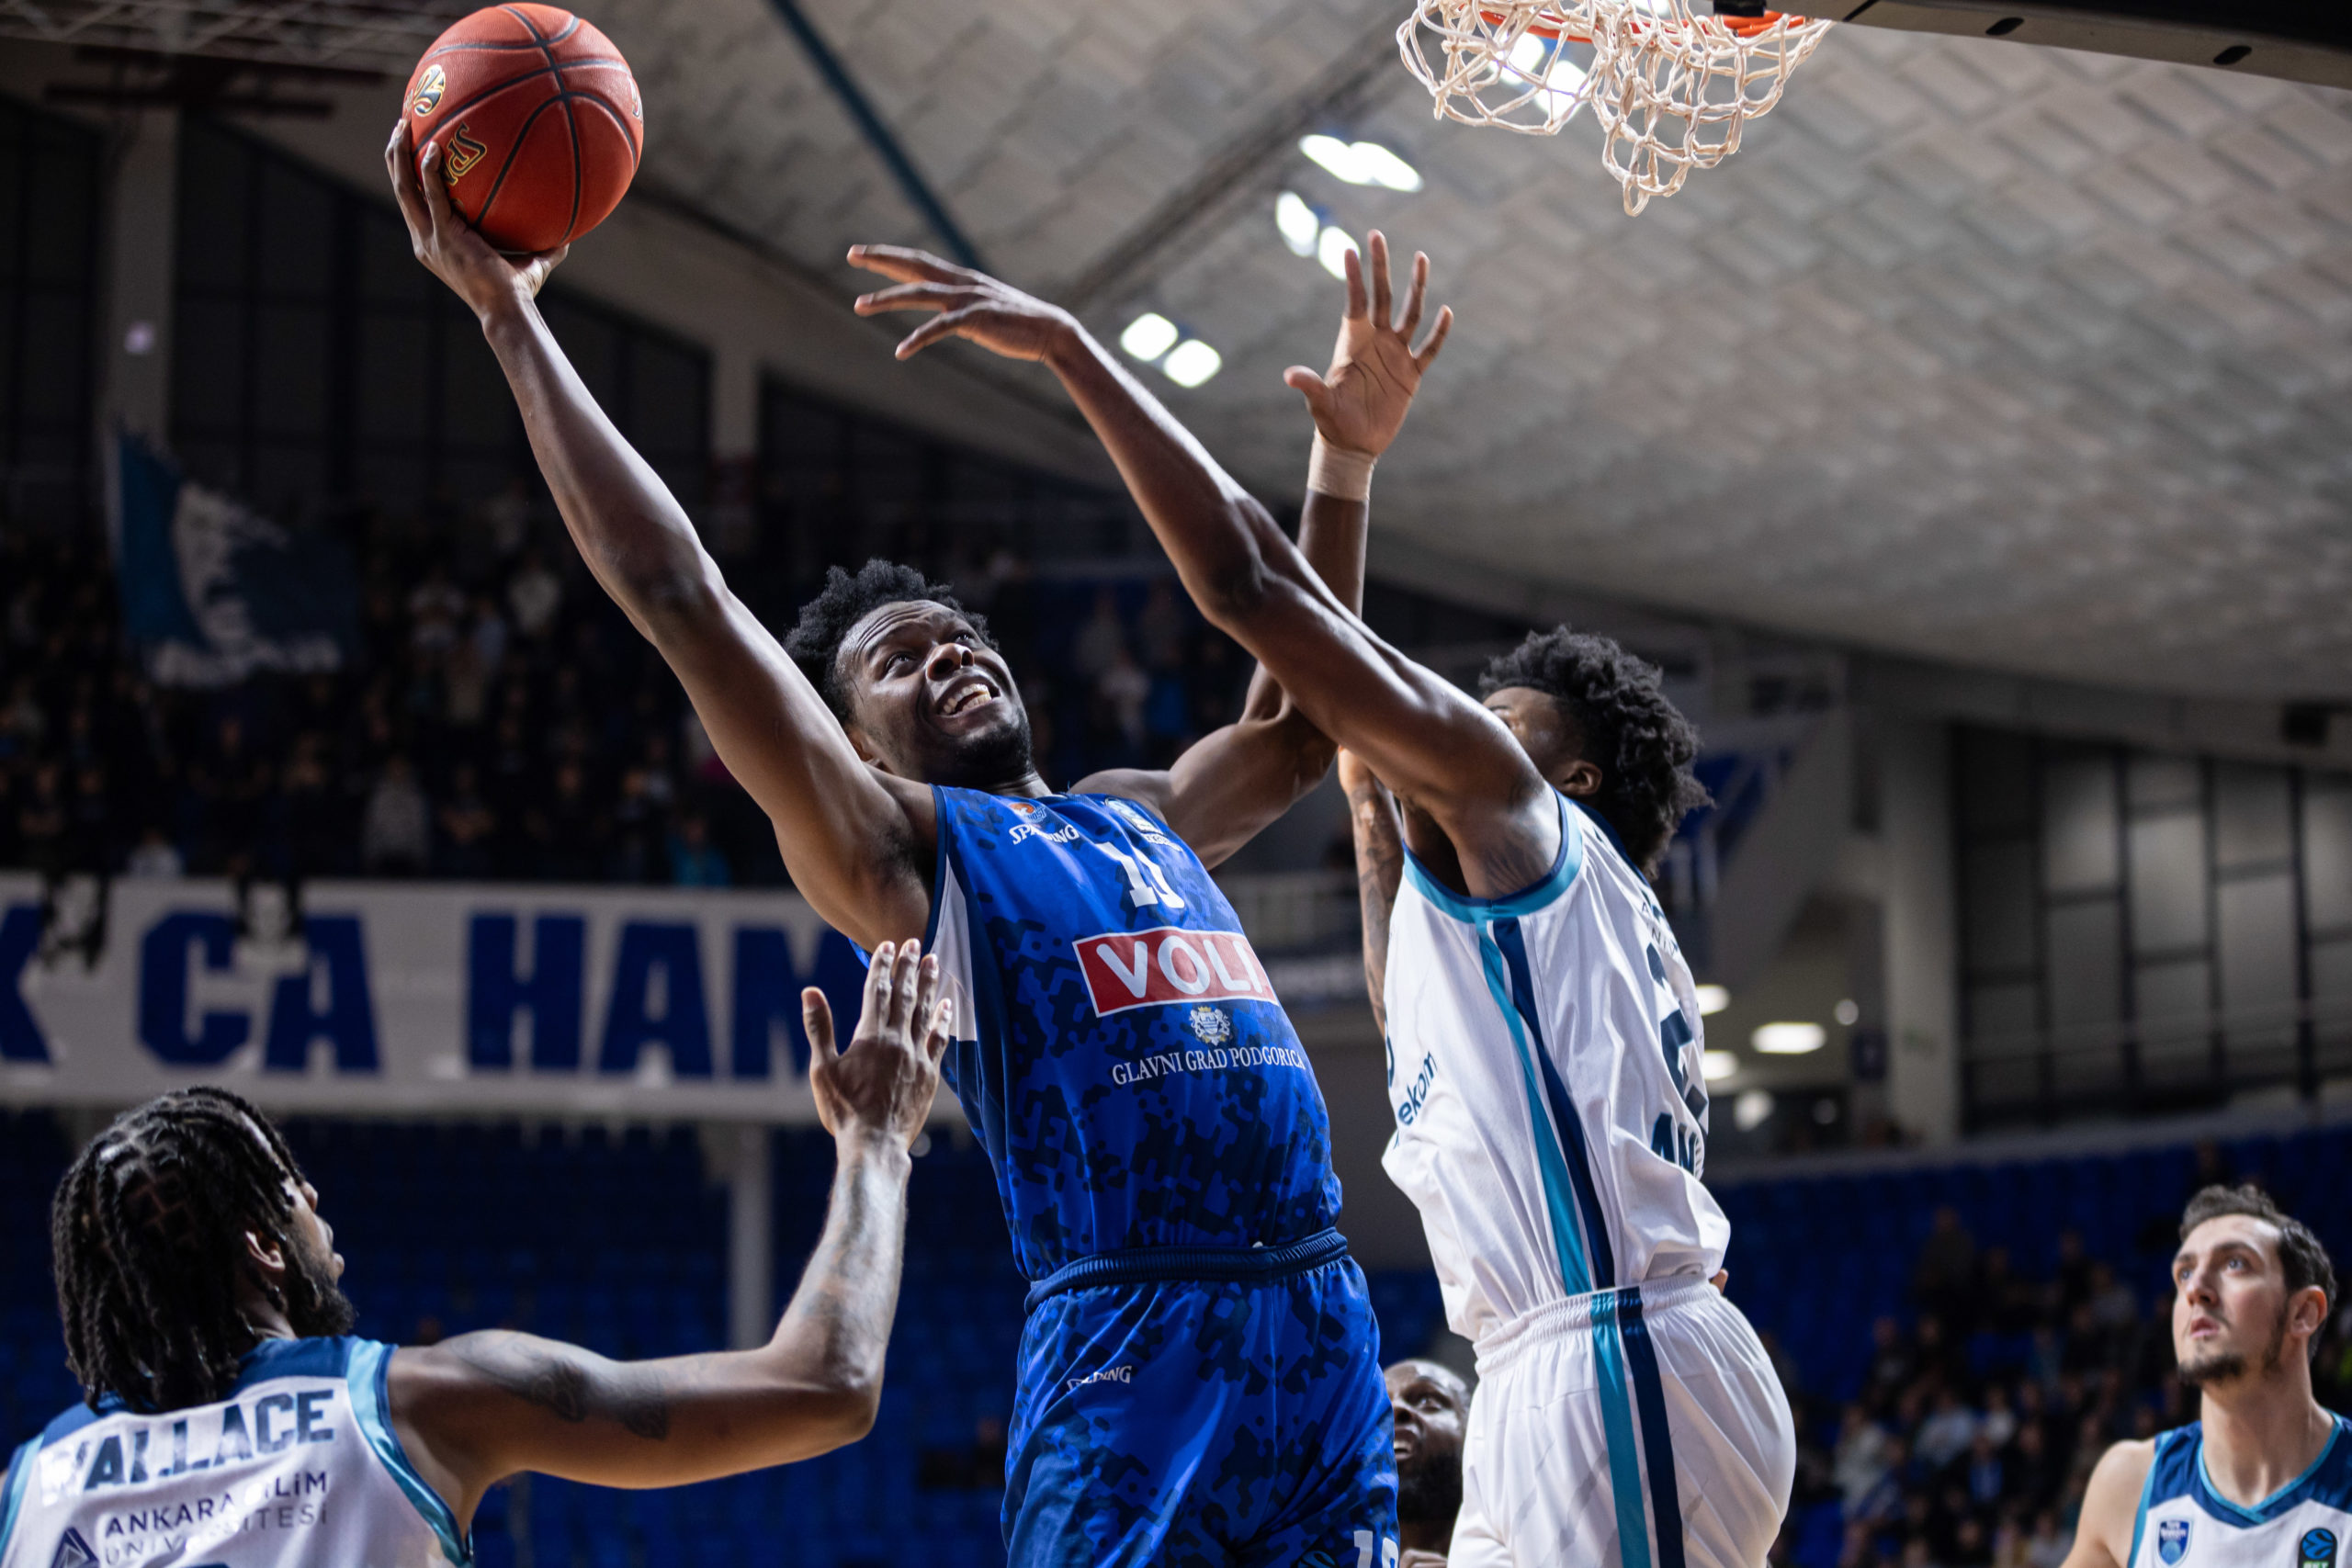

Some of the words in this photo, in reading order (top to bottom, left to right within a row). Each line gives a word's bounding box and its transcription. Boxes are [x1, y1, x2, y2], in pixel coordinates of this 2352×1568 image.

[137, 908, 379, 1072] CA
[1096, 935, 1263, 998] VOLI
[1112, 1051, 1183, 1086] GLAVNI
[1185, 1048, 1227, 1072] GRAD
[1228, 1045, 1306, 1071] PODGORICA
[41, 1388, 335, 1501] ALLACE
[105, 1493, 235, 1539] ANKARA
